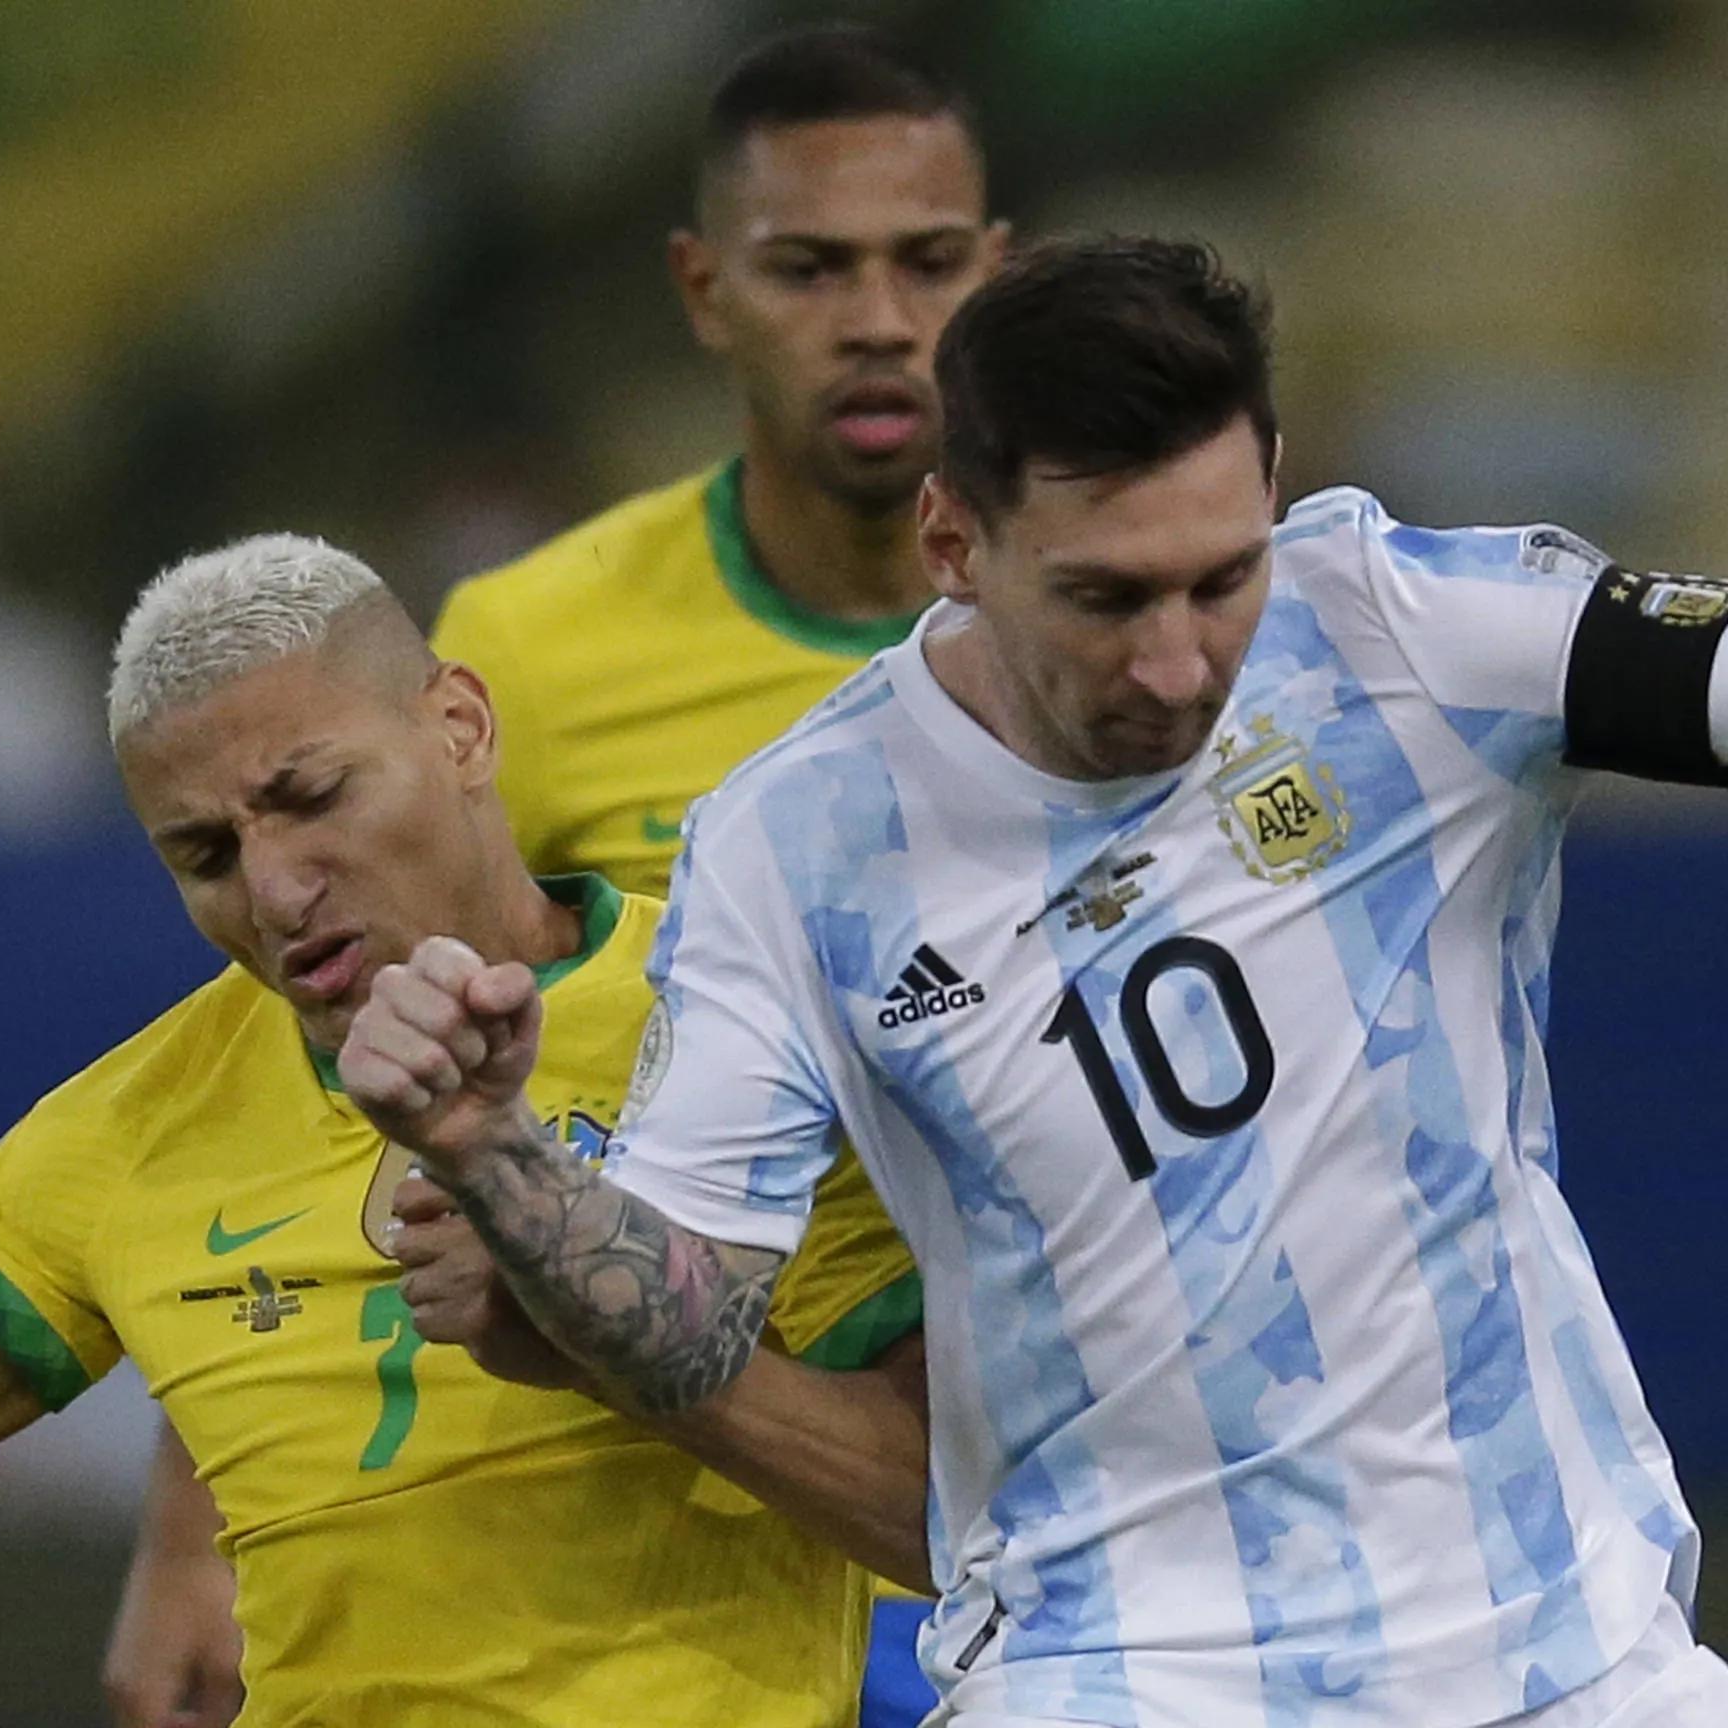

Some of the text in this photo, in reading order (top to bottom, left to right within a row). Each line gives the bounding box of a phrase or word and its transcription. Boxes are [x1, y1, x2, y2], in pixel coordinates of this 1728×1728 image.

[878, 982, 986, 1029] adidas
[1039, 936, 1275, 1183] 10
[359, 1284, 426, 1471] 7
